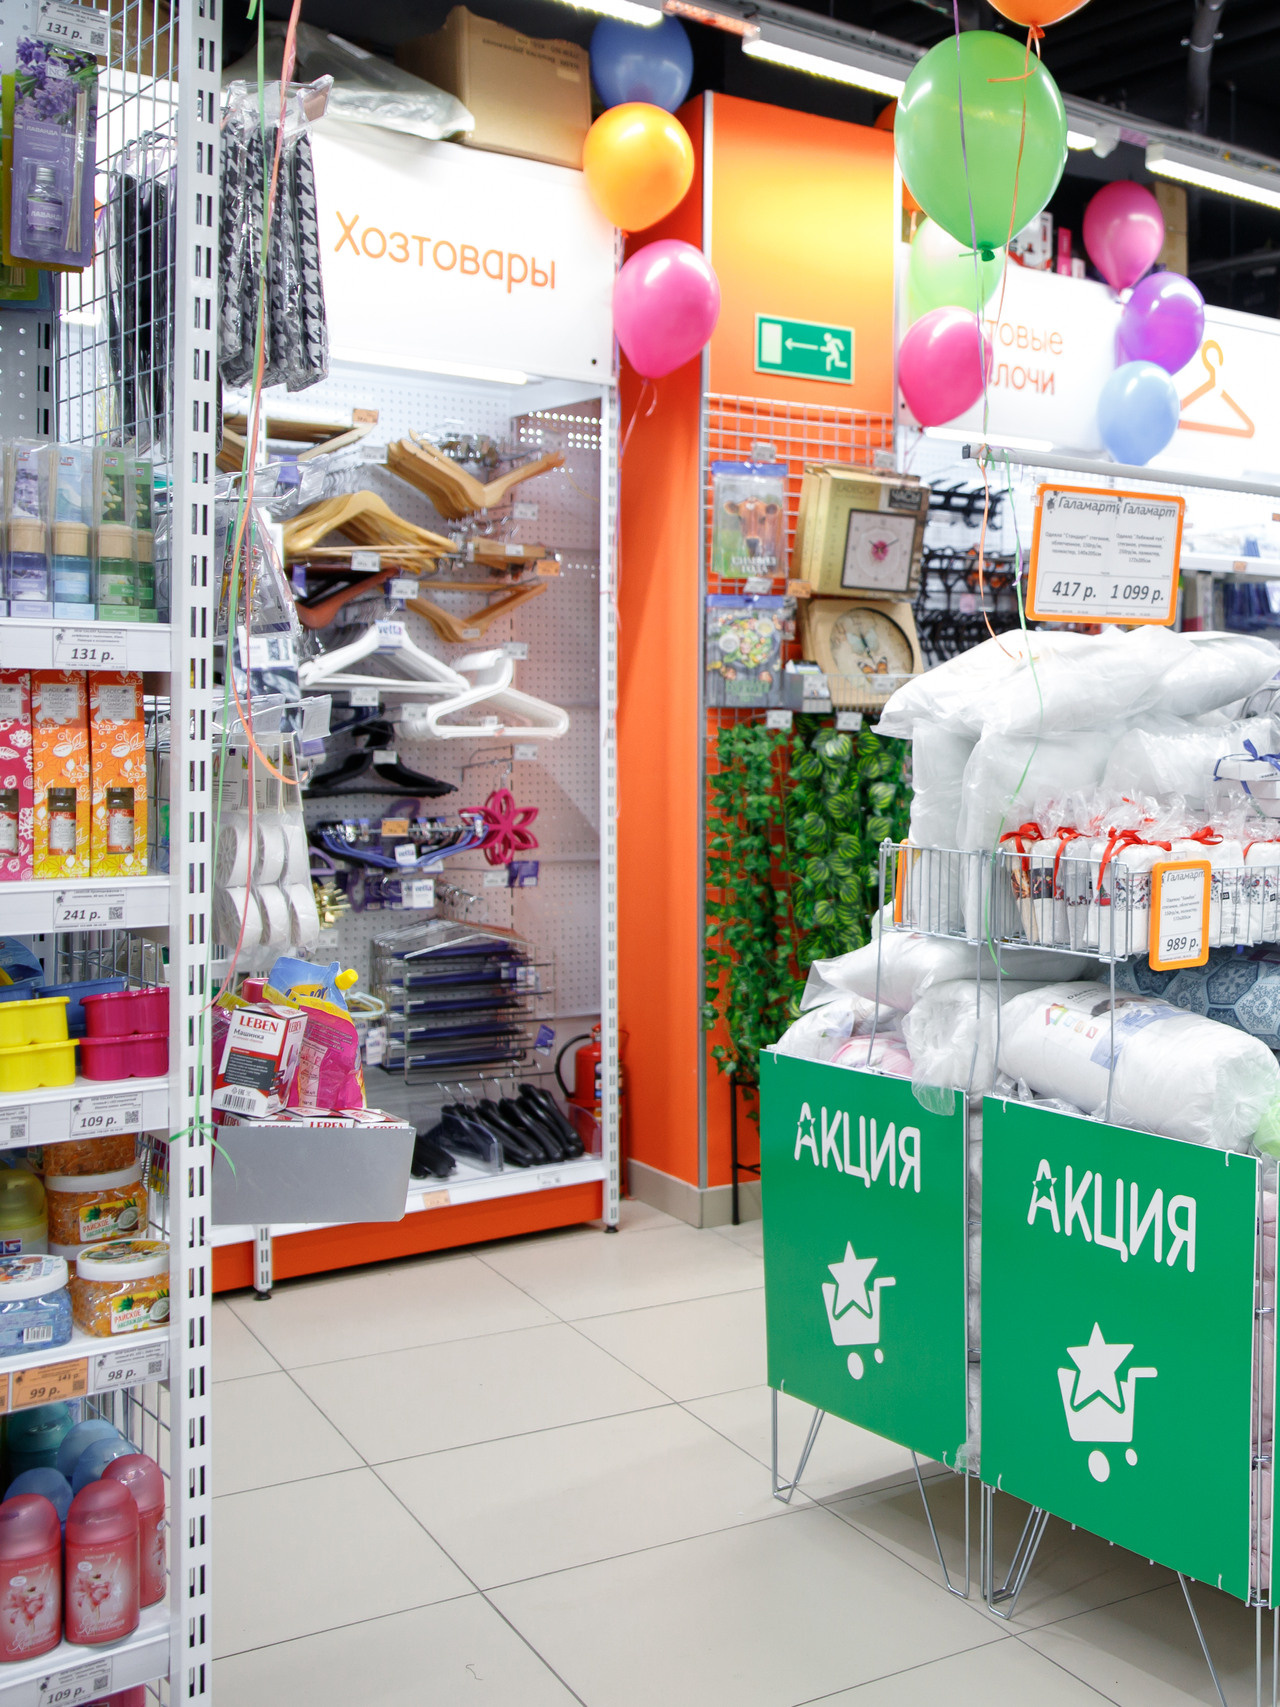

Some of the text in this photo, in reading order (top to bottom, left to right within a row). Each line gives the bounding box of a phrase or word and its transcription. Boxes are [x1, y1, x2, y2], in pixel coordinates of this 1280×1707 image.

[46, 22, 83, 39] 131 р.
[334, 210, 555, 294] Хозтовары
[985, 319, 1063, 355] товые
[993, 363, 1054, 395] лочи
[1058, 497, 1116, 515] Галамарт
[1122, 502, 1176, 520] Галамарт
[1052, 581, 1097, 601] 417 р.
[1110, 584, 1164, 604] 1 099 р.
[71, 648, 115, 663] 131 р.
[1166, 870, 1205, 882] Галамарт
[63, 909, 101, 923] 241 р.
[1166, 936, 1199, 952] 989 р.
[239, 1015, 279, 1033] LEBEN
[233, 1028, 265, 1040] Машинка
[80, 1115, 117, 1128] 109 р.
[793, 1102, 921, 1193] АКЦИЯ
[1027, 1158, 1197, 1273] АКЦИЯ
[82, 1218, 109, 1233] РАЙСКОЕ
[114, 1309, 141, 1324] РАЙСКОЕ
[108, 1368, 137, 1381] 98 р.
[30, 1386, 61, 1399] 99 р.
[47, 1687, 86, 1704] 109 р.
